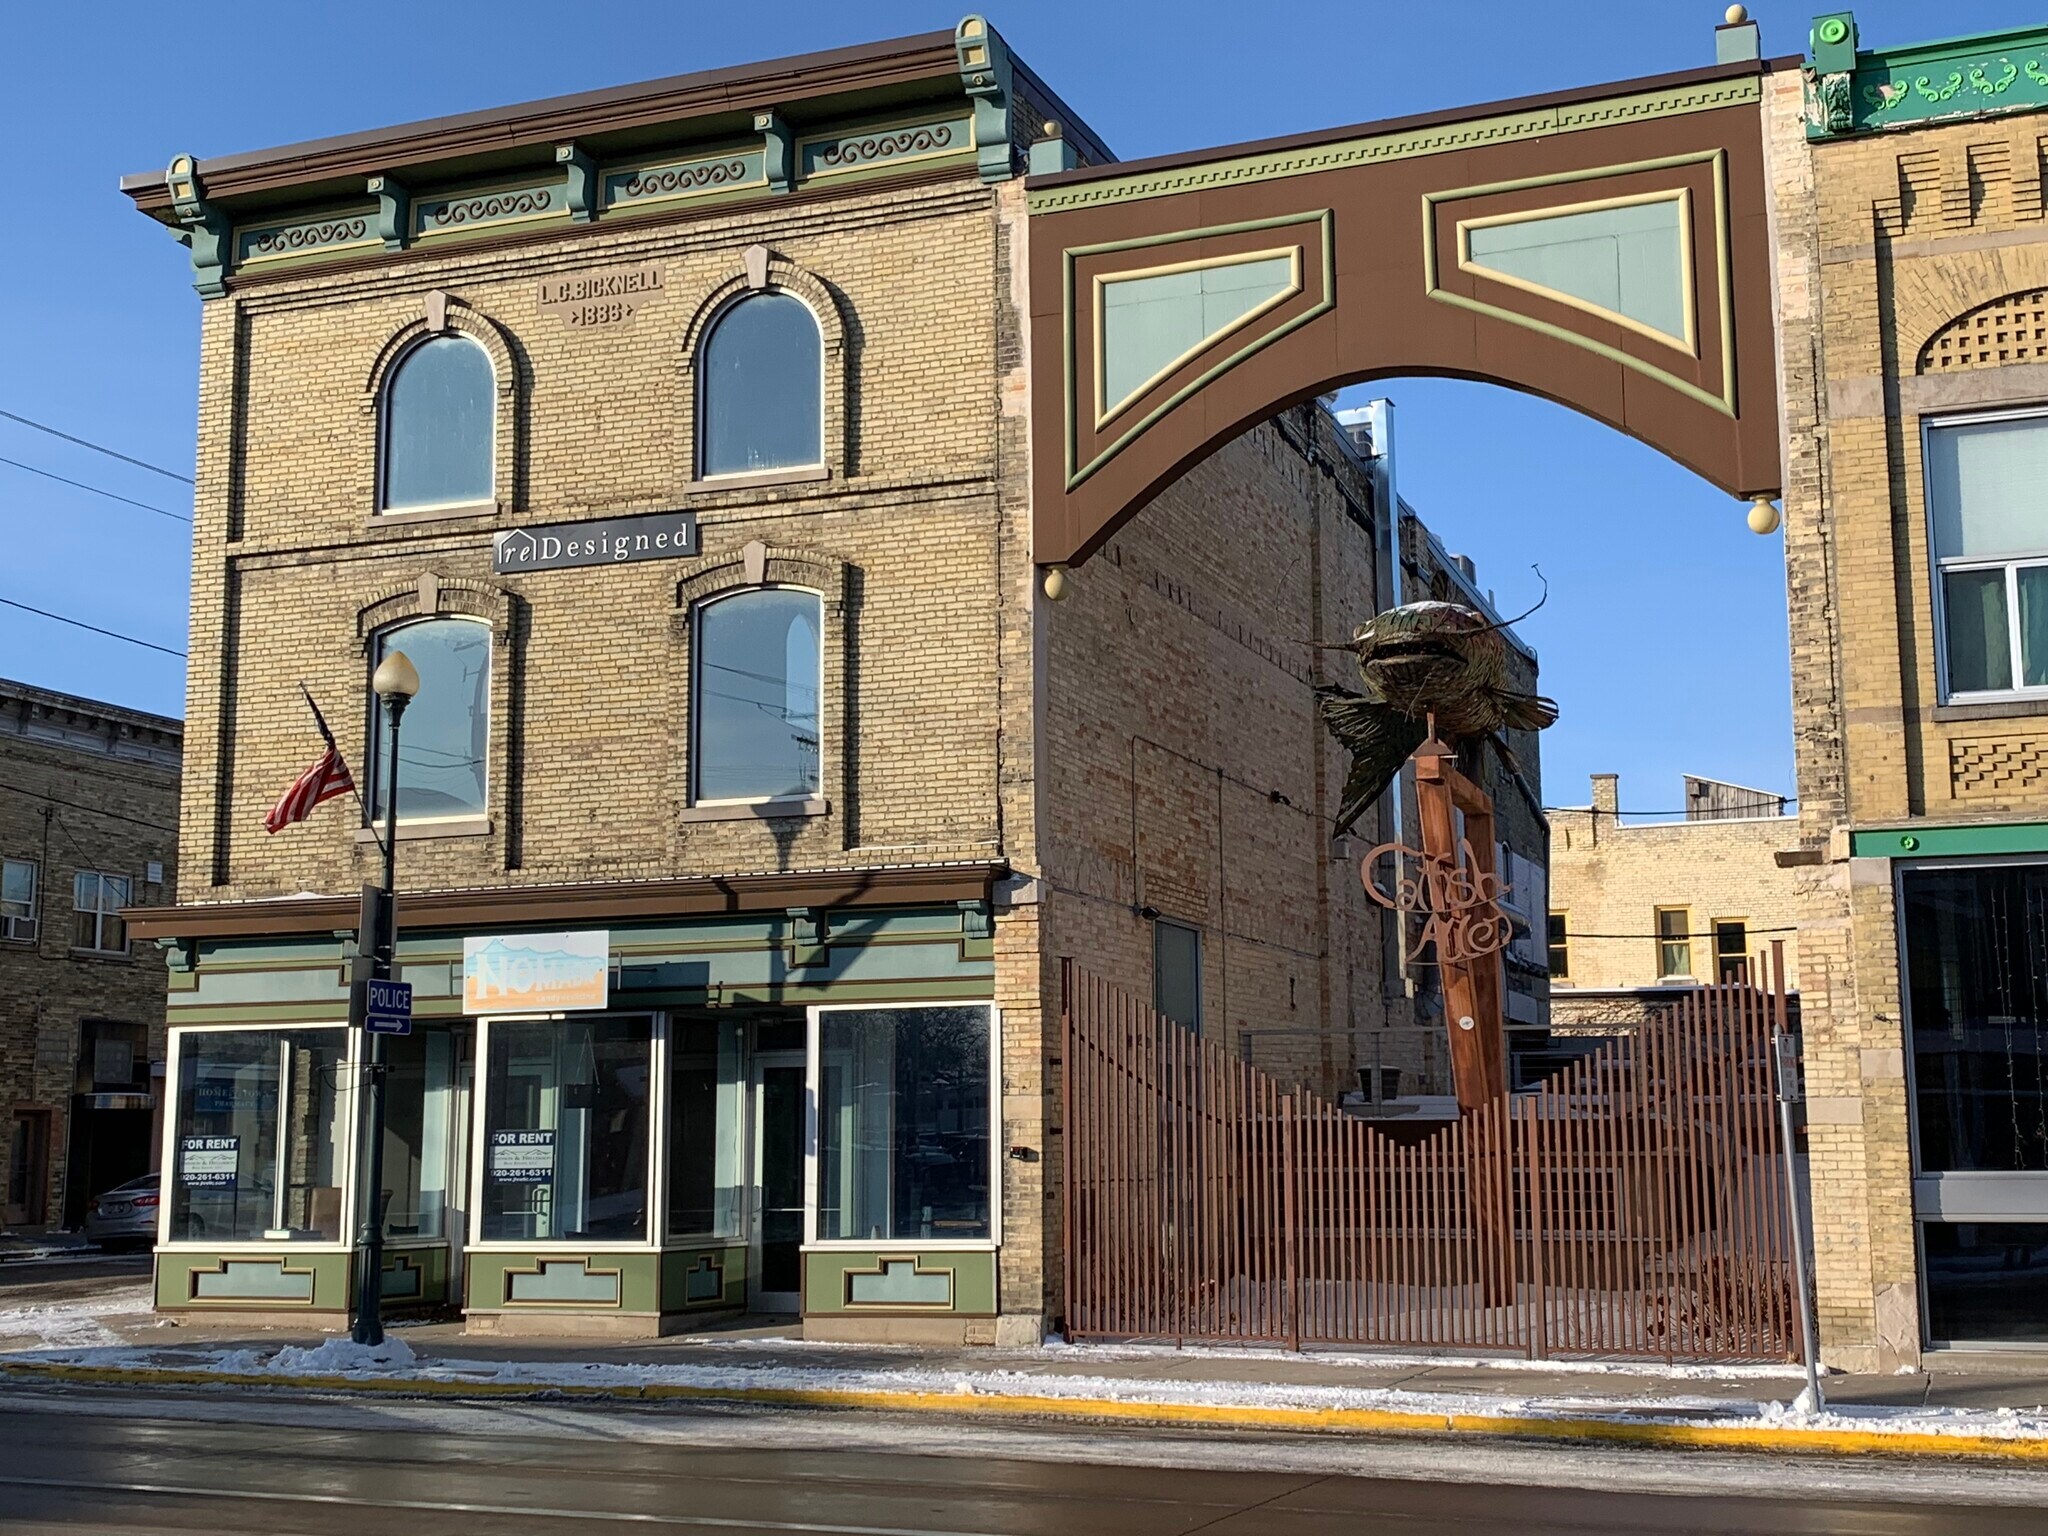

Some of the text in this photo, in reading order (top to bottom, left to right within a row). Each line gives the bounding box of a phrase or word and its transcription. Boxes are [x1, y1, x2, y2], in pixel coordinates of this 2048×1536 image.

[370, 987, 410, 1010] POLICE
[181, 1138, 237, 1150] FOR RENT
[491, 1133, 553, 1144] FOR RENT
